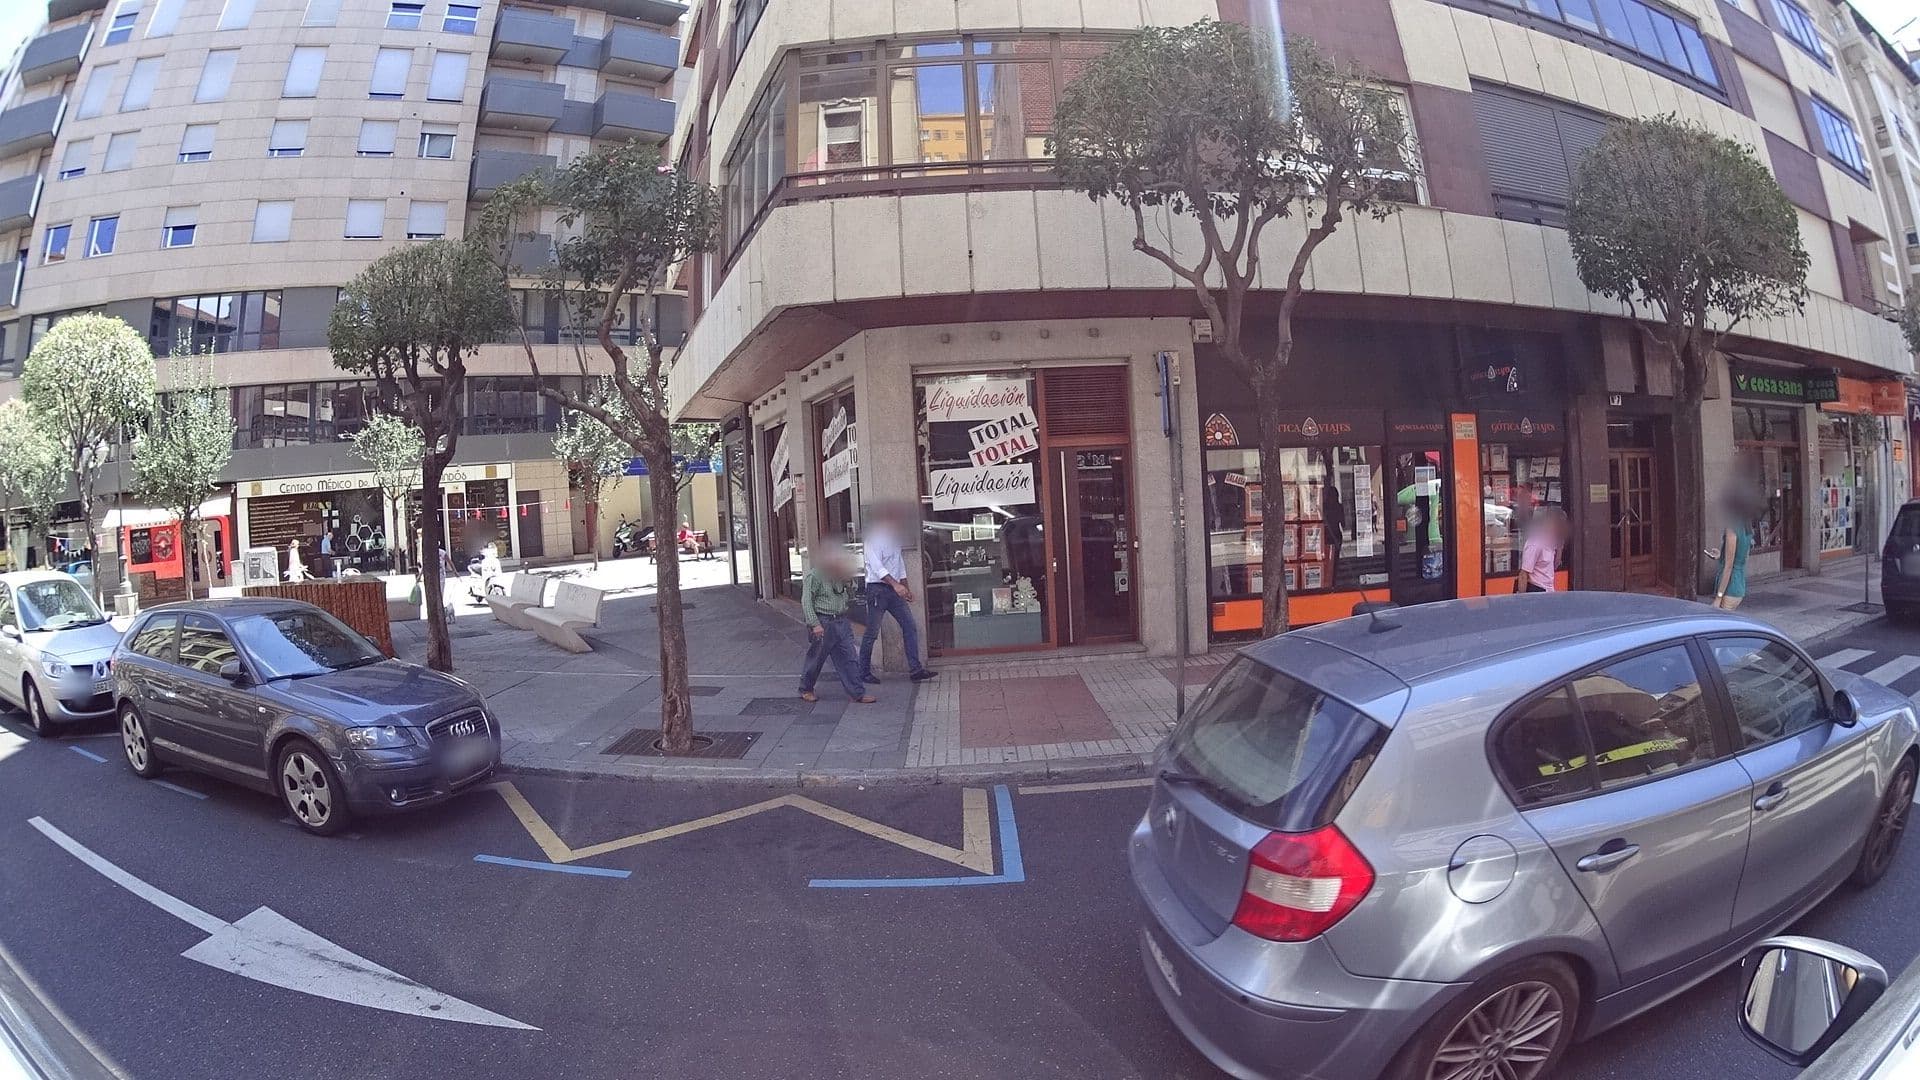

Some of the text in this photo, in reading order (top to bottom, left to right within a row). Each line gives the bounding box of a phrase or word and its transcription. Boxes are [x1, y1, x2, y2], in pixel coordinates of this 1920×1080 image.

[929, 385, 1025, 419] Liquidación
[972, 412, 1033, 445] TOTAL
[1319, 423, 1351, 435] VIAJES
[973, 434, 1034, 467] TOTAL
[934, 470, 1031, 505] Liquidación
